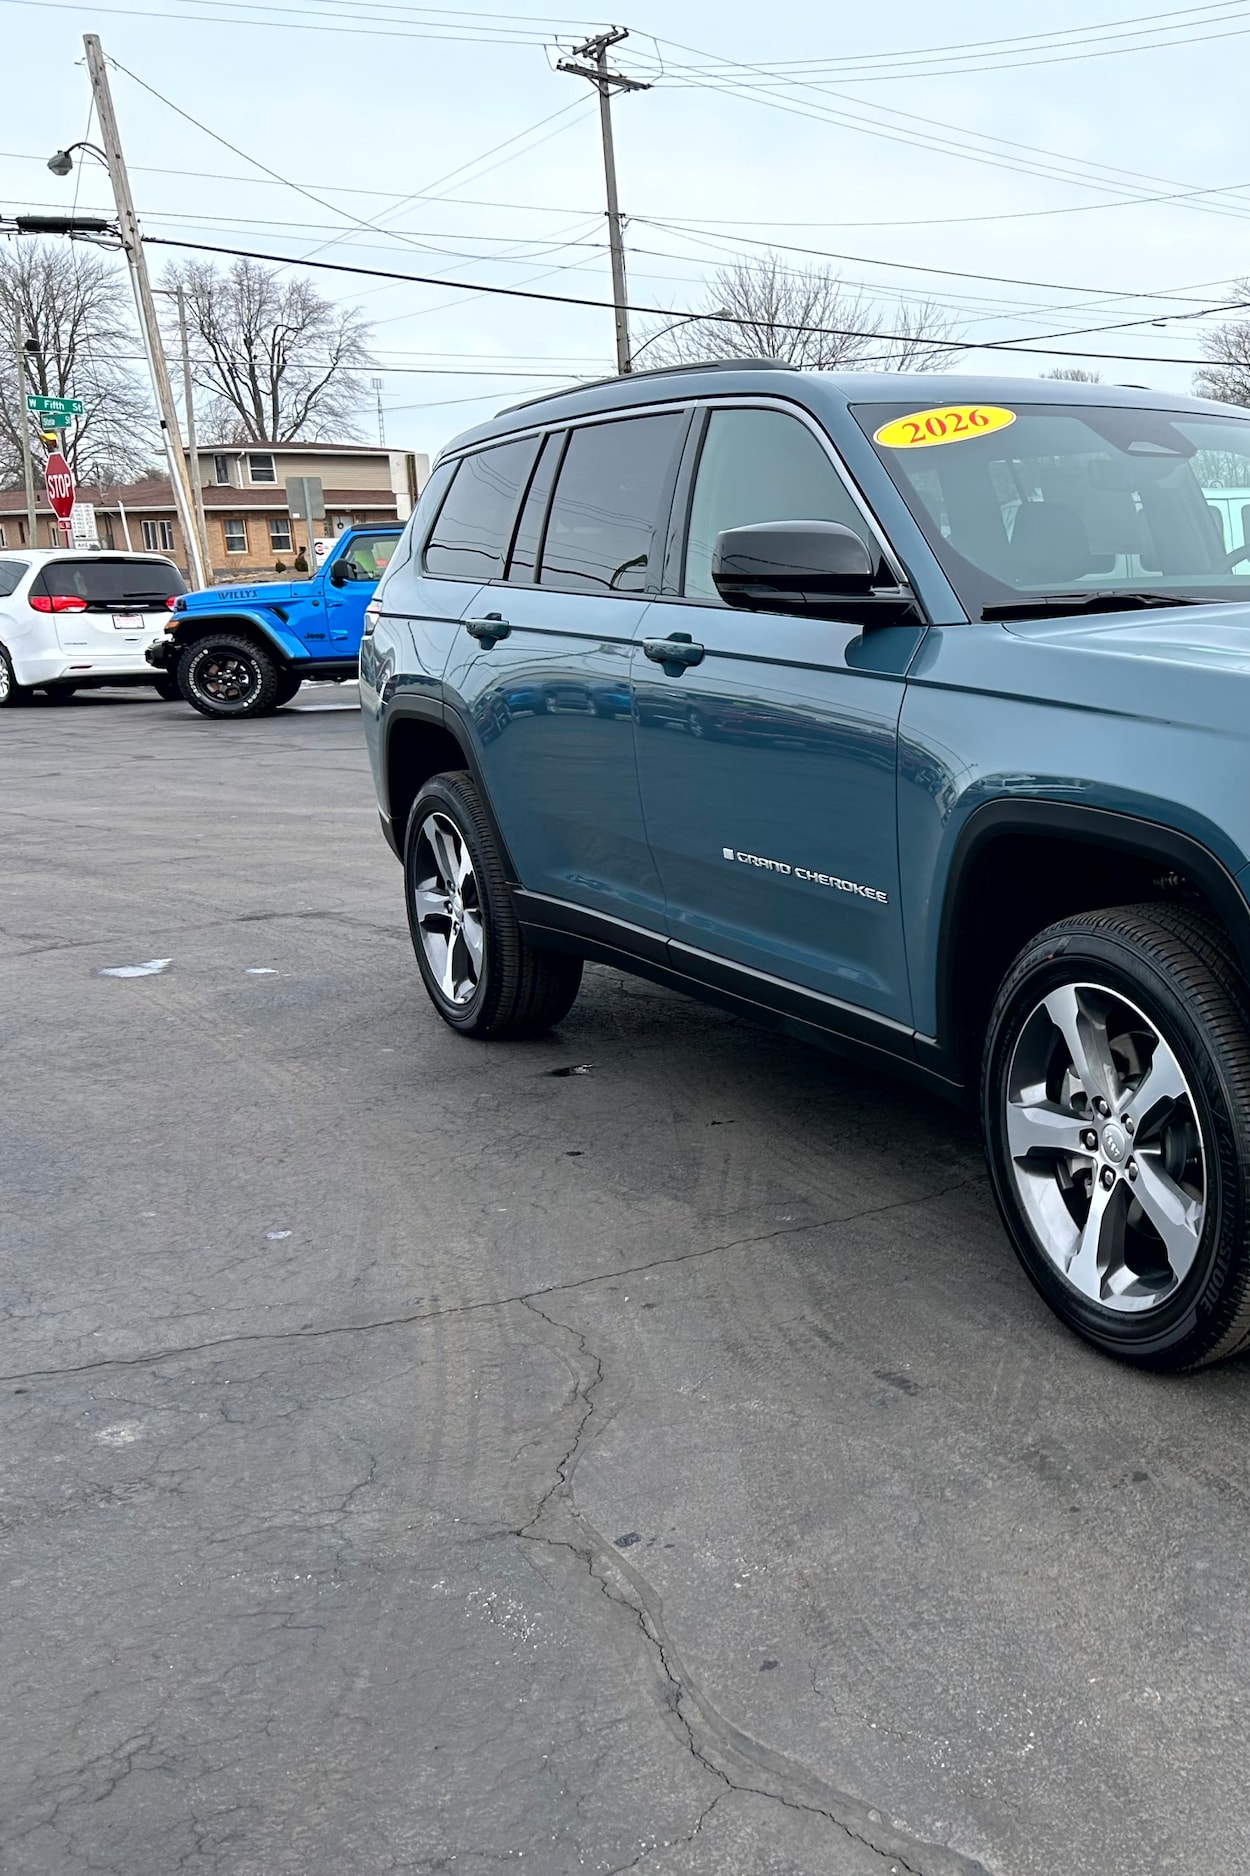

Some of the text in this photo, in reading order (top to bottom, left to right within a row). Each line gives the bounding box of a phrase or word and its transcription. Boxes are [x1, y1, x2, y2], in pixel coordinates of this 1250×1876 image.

[29, 398, 81, 412] W Fifth St
[901, 409, 989, 443] 2026
[47, 473, 71, 499] STOP
[217, 590, 259, 600] WILLYS
[737, 851, 889, 904] GRAND CHEROKEE
